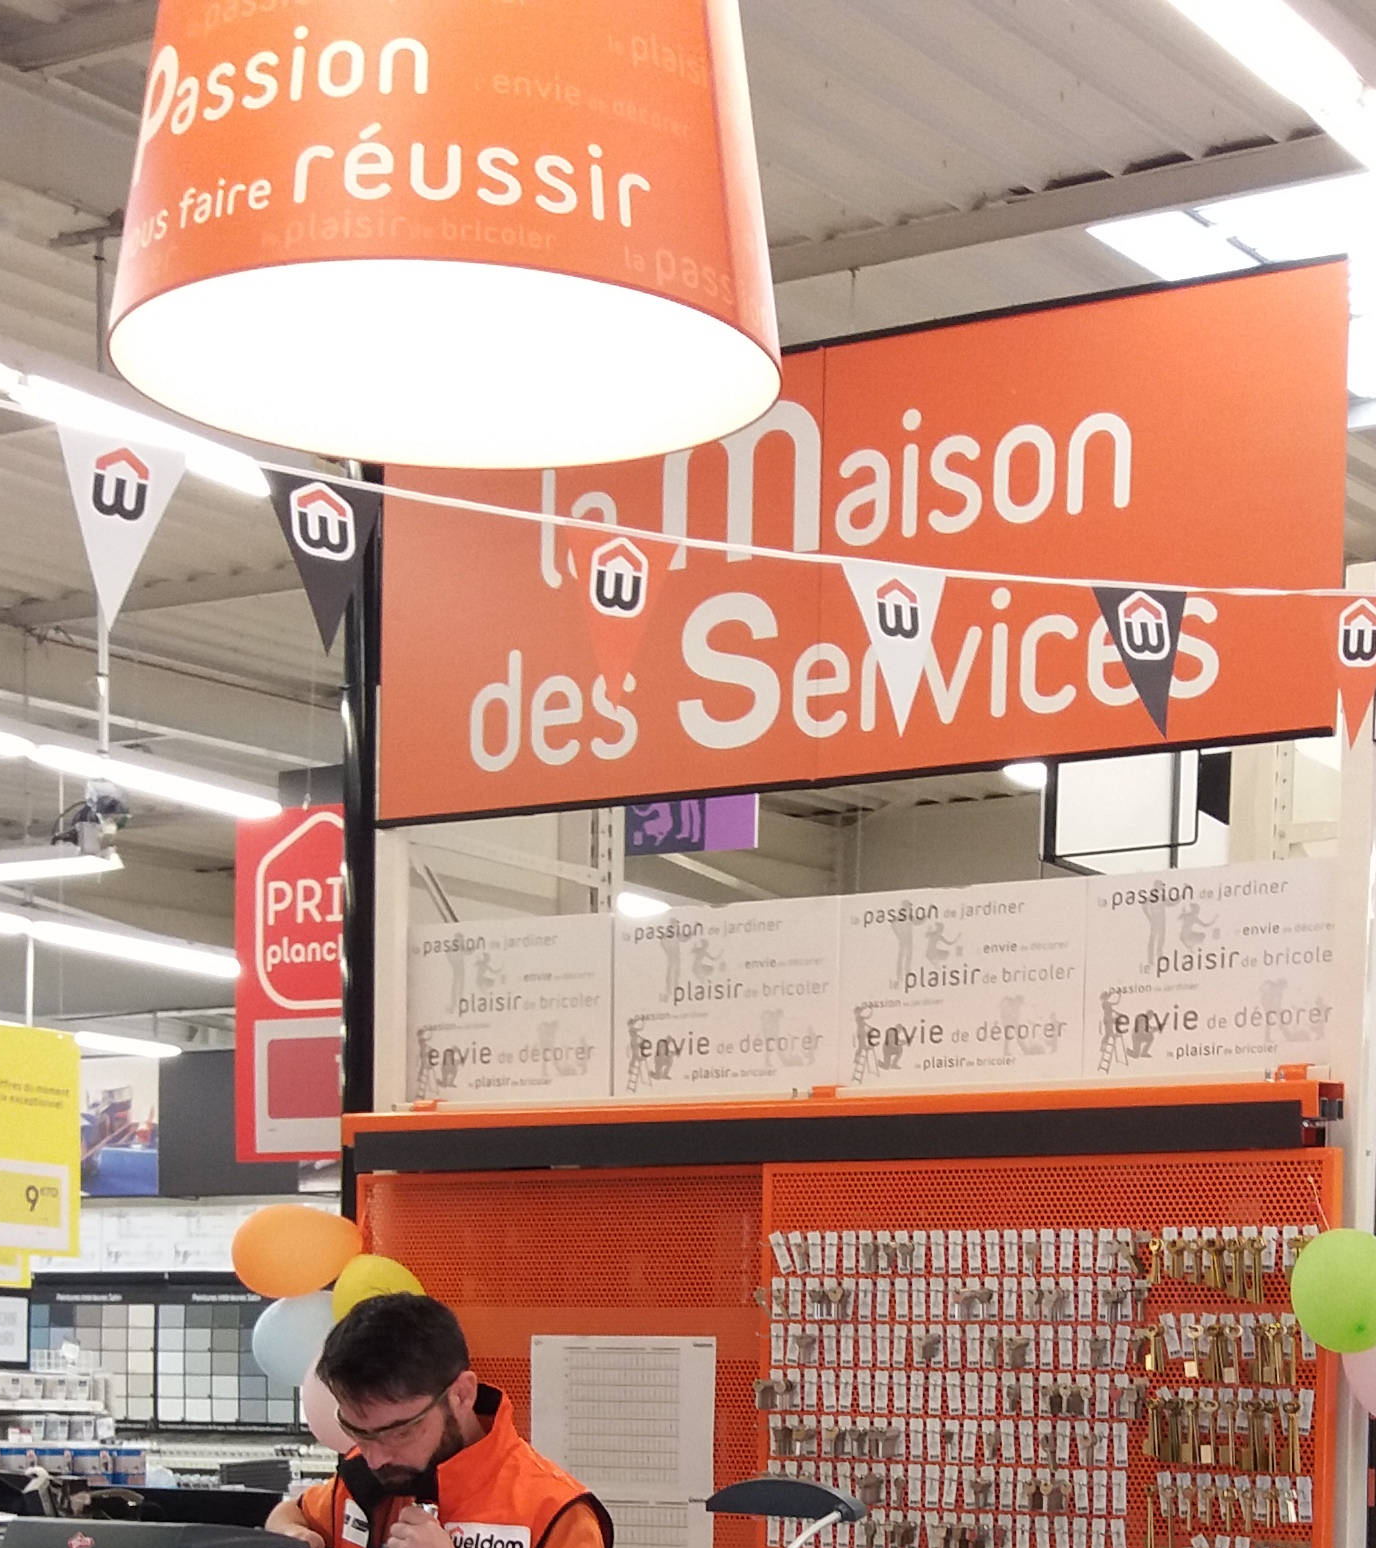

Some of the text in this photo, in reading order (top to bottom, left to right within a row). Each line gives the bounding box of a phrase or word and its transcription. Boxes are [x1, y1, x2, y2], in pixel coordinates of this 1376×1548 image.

[179, 176, 272, 230] faire
[292, 122, 652, 229] réussir
[468, 648, 639, 776] des
[1112, 883, 1194, 910] passion
[1217, 880, 1288, 901] jardiner
[863, 903, 939, 928] passion
[960, 901, 1026, 920] jardiner
[634, 920, 704, 944] passion
[1242, 922, 1280, 937] envie
[423, 936, 486, 957] passion
[1156, 946, 1240, 978] plaisir
[904, 963, 981, 993] plaisir
[1001, 964, 1076, 983] bricoler
[458, 993, 523, 1018] plaisir
[673, 979, 744, 1006] plaisir
[1114, 1004, 1333, 1034] envie de décorer
[639, 1031, 711, 1058] envie
[867, 1019, 1068, 1047] envie de décorer
[427, 1041, 493, 1067] envie
[923, 1055, 966, 1071] plaisir
[1176, 1043, 1224, 1060] plaisir
